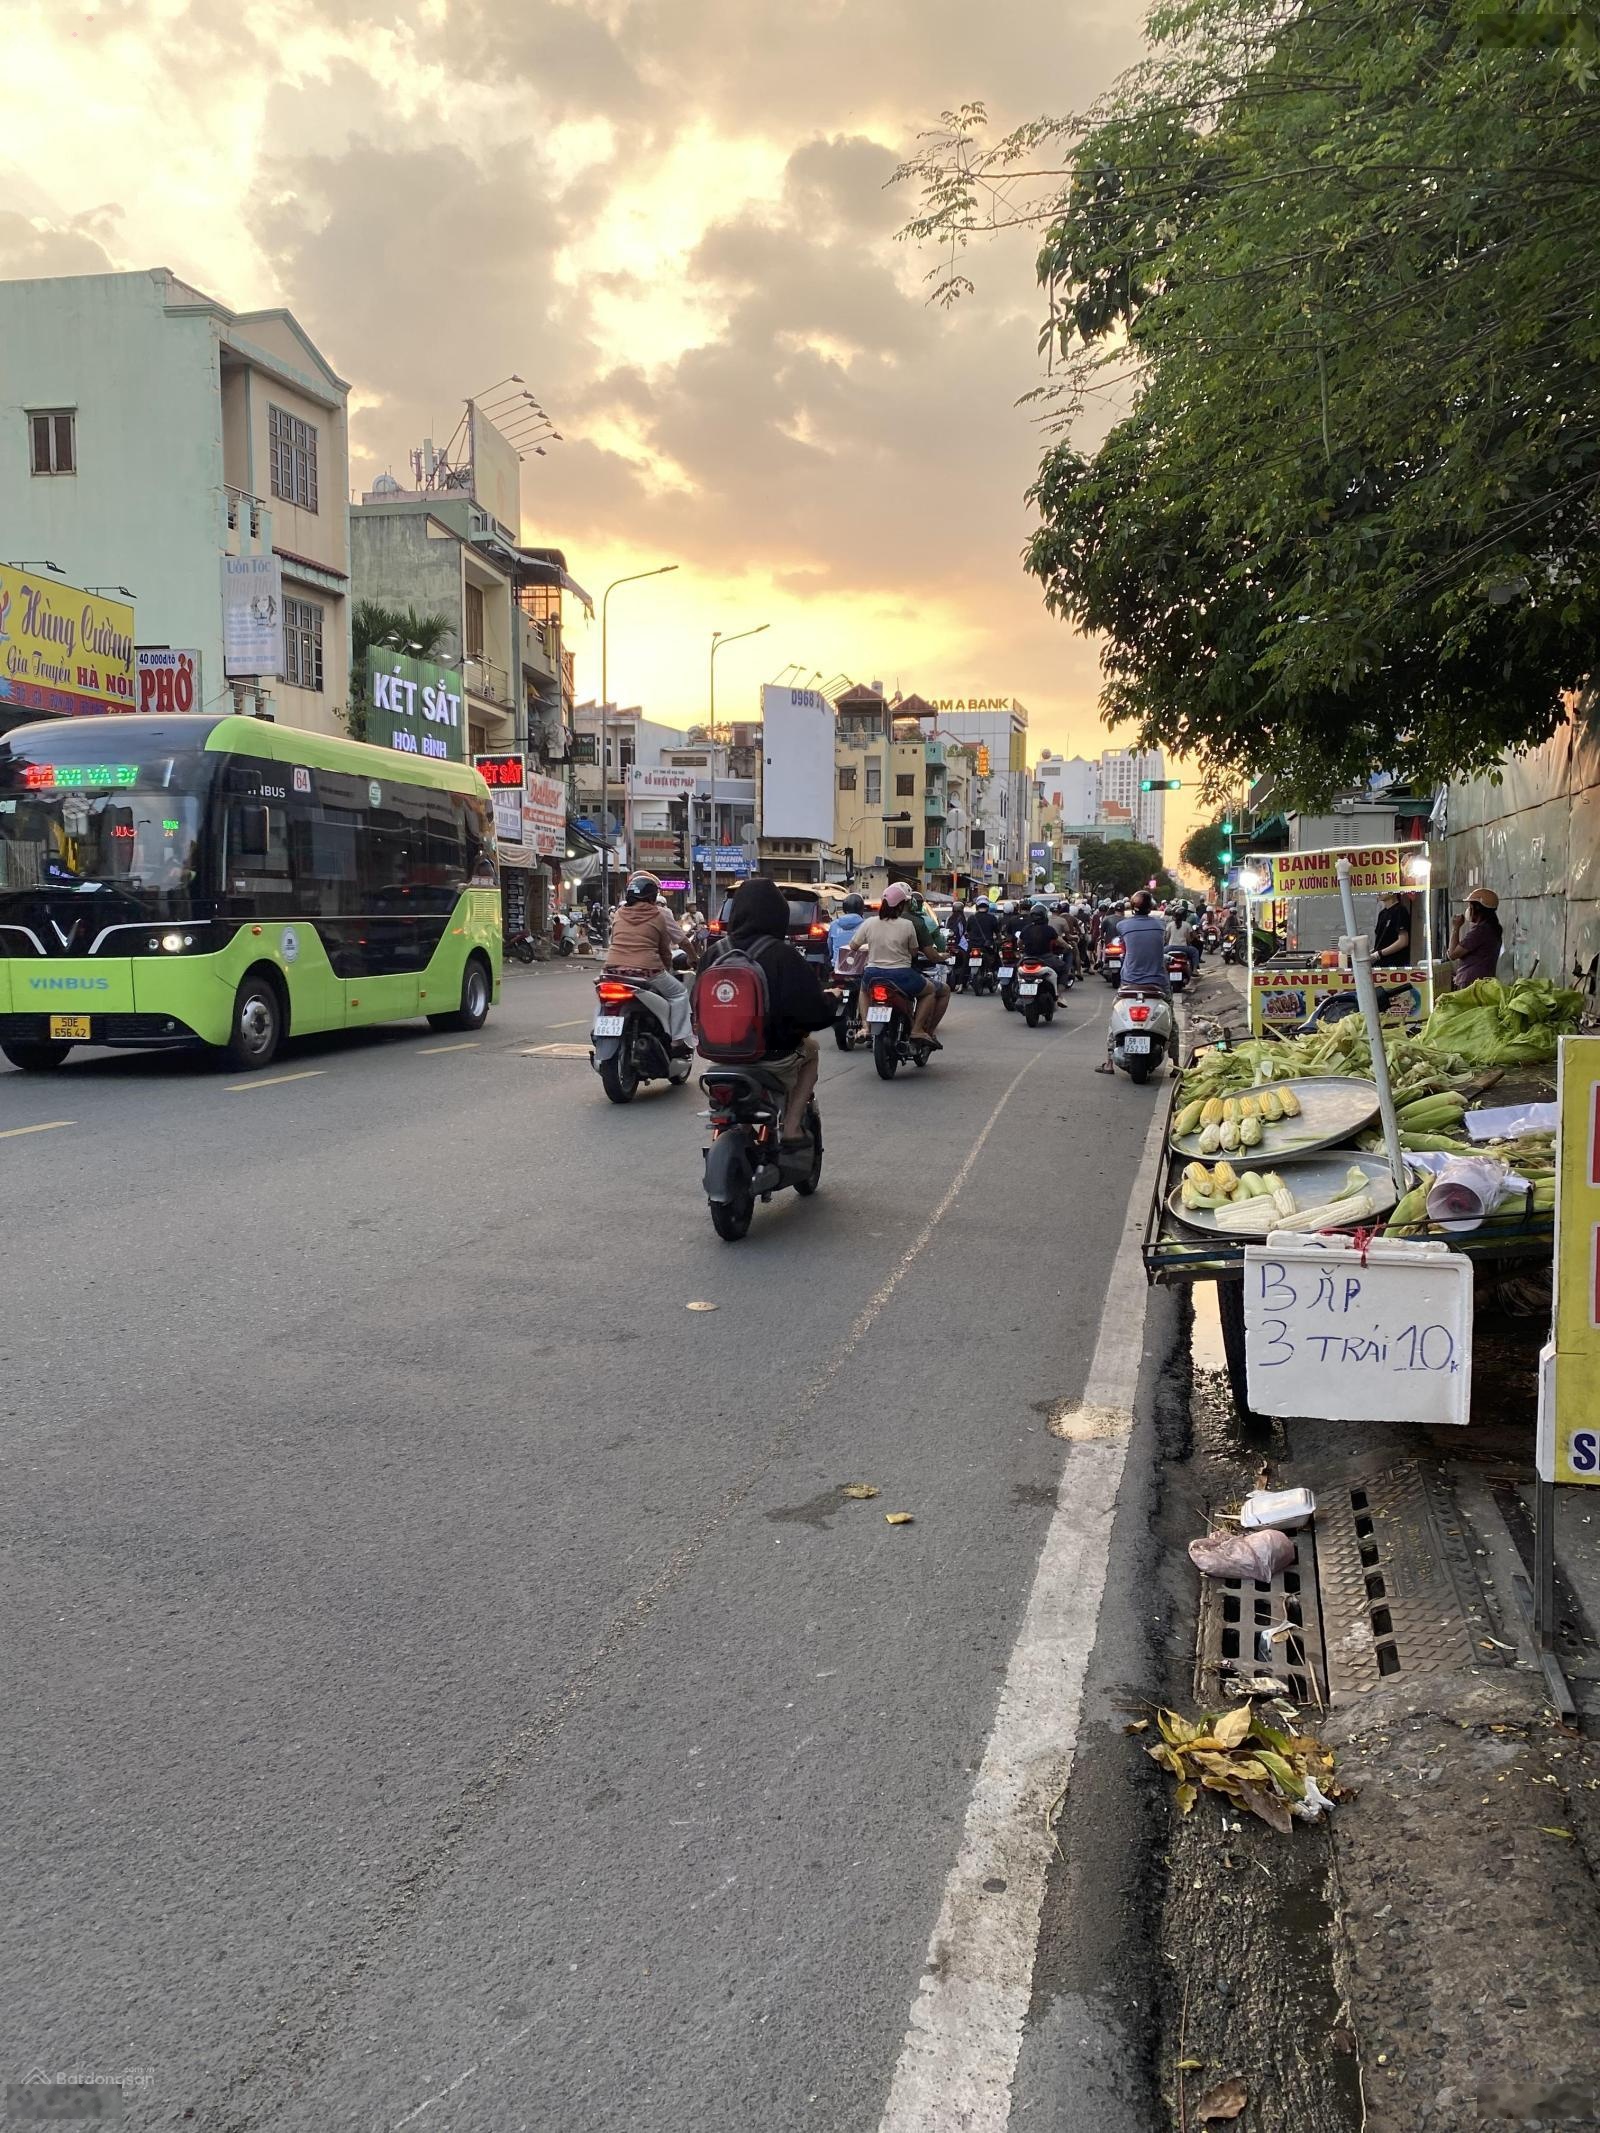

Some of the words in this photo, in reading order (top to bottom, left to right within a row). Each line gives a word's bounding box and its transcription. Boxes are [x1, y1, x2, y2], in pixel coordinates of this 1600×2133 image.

[20, 585, 77, 658] Hùng
[81, 604, 133, 673] Cường
[77, 664, 100, 689] HÀ
[105, 672, 134, 699] NỘI
[139, 653, 194, 713] PHỞ
[374, 665, 417, 716] KÉT
[422, 679, 461, 727] SẮT
[791, 690, 814, 708] 0968
[968, 698, 1008, 709] BANK
[393, 727, 418, 753] HÒA
[422, 733, 447, 759] BÌNH
[296, 770, 308, 790] 64
[1279, 879, 1295, 893] LẠP
[1331, 874, 1363, 888] NNG
[1381, 872, 1397, 885] 15K
[29, 977, 109, 990] VINBUS
[1253, 972, 1328, 986] BÁNH
[1258, 1319, 1295, 1366] 3
[1573, 1433, 1600, 1471] S
